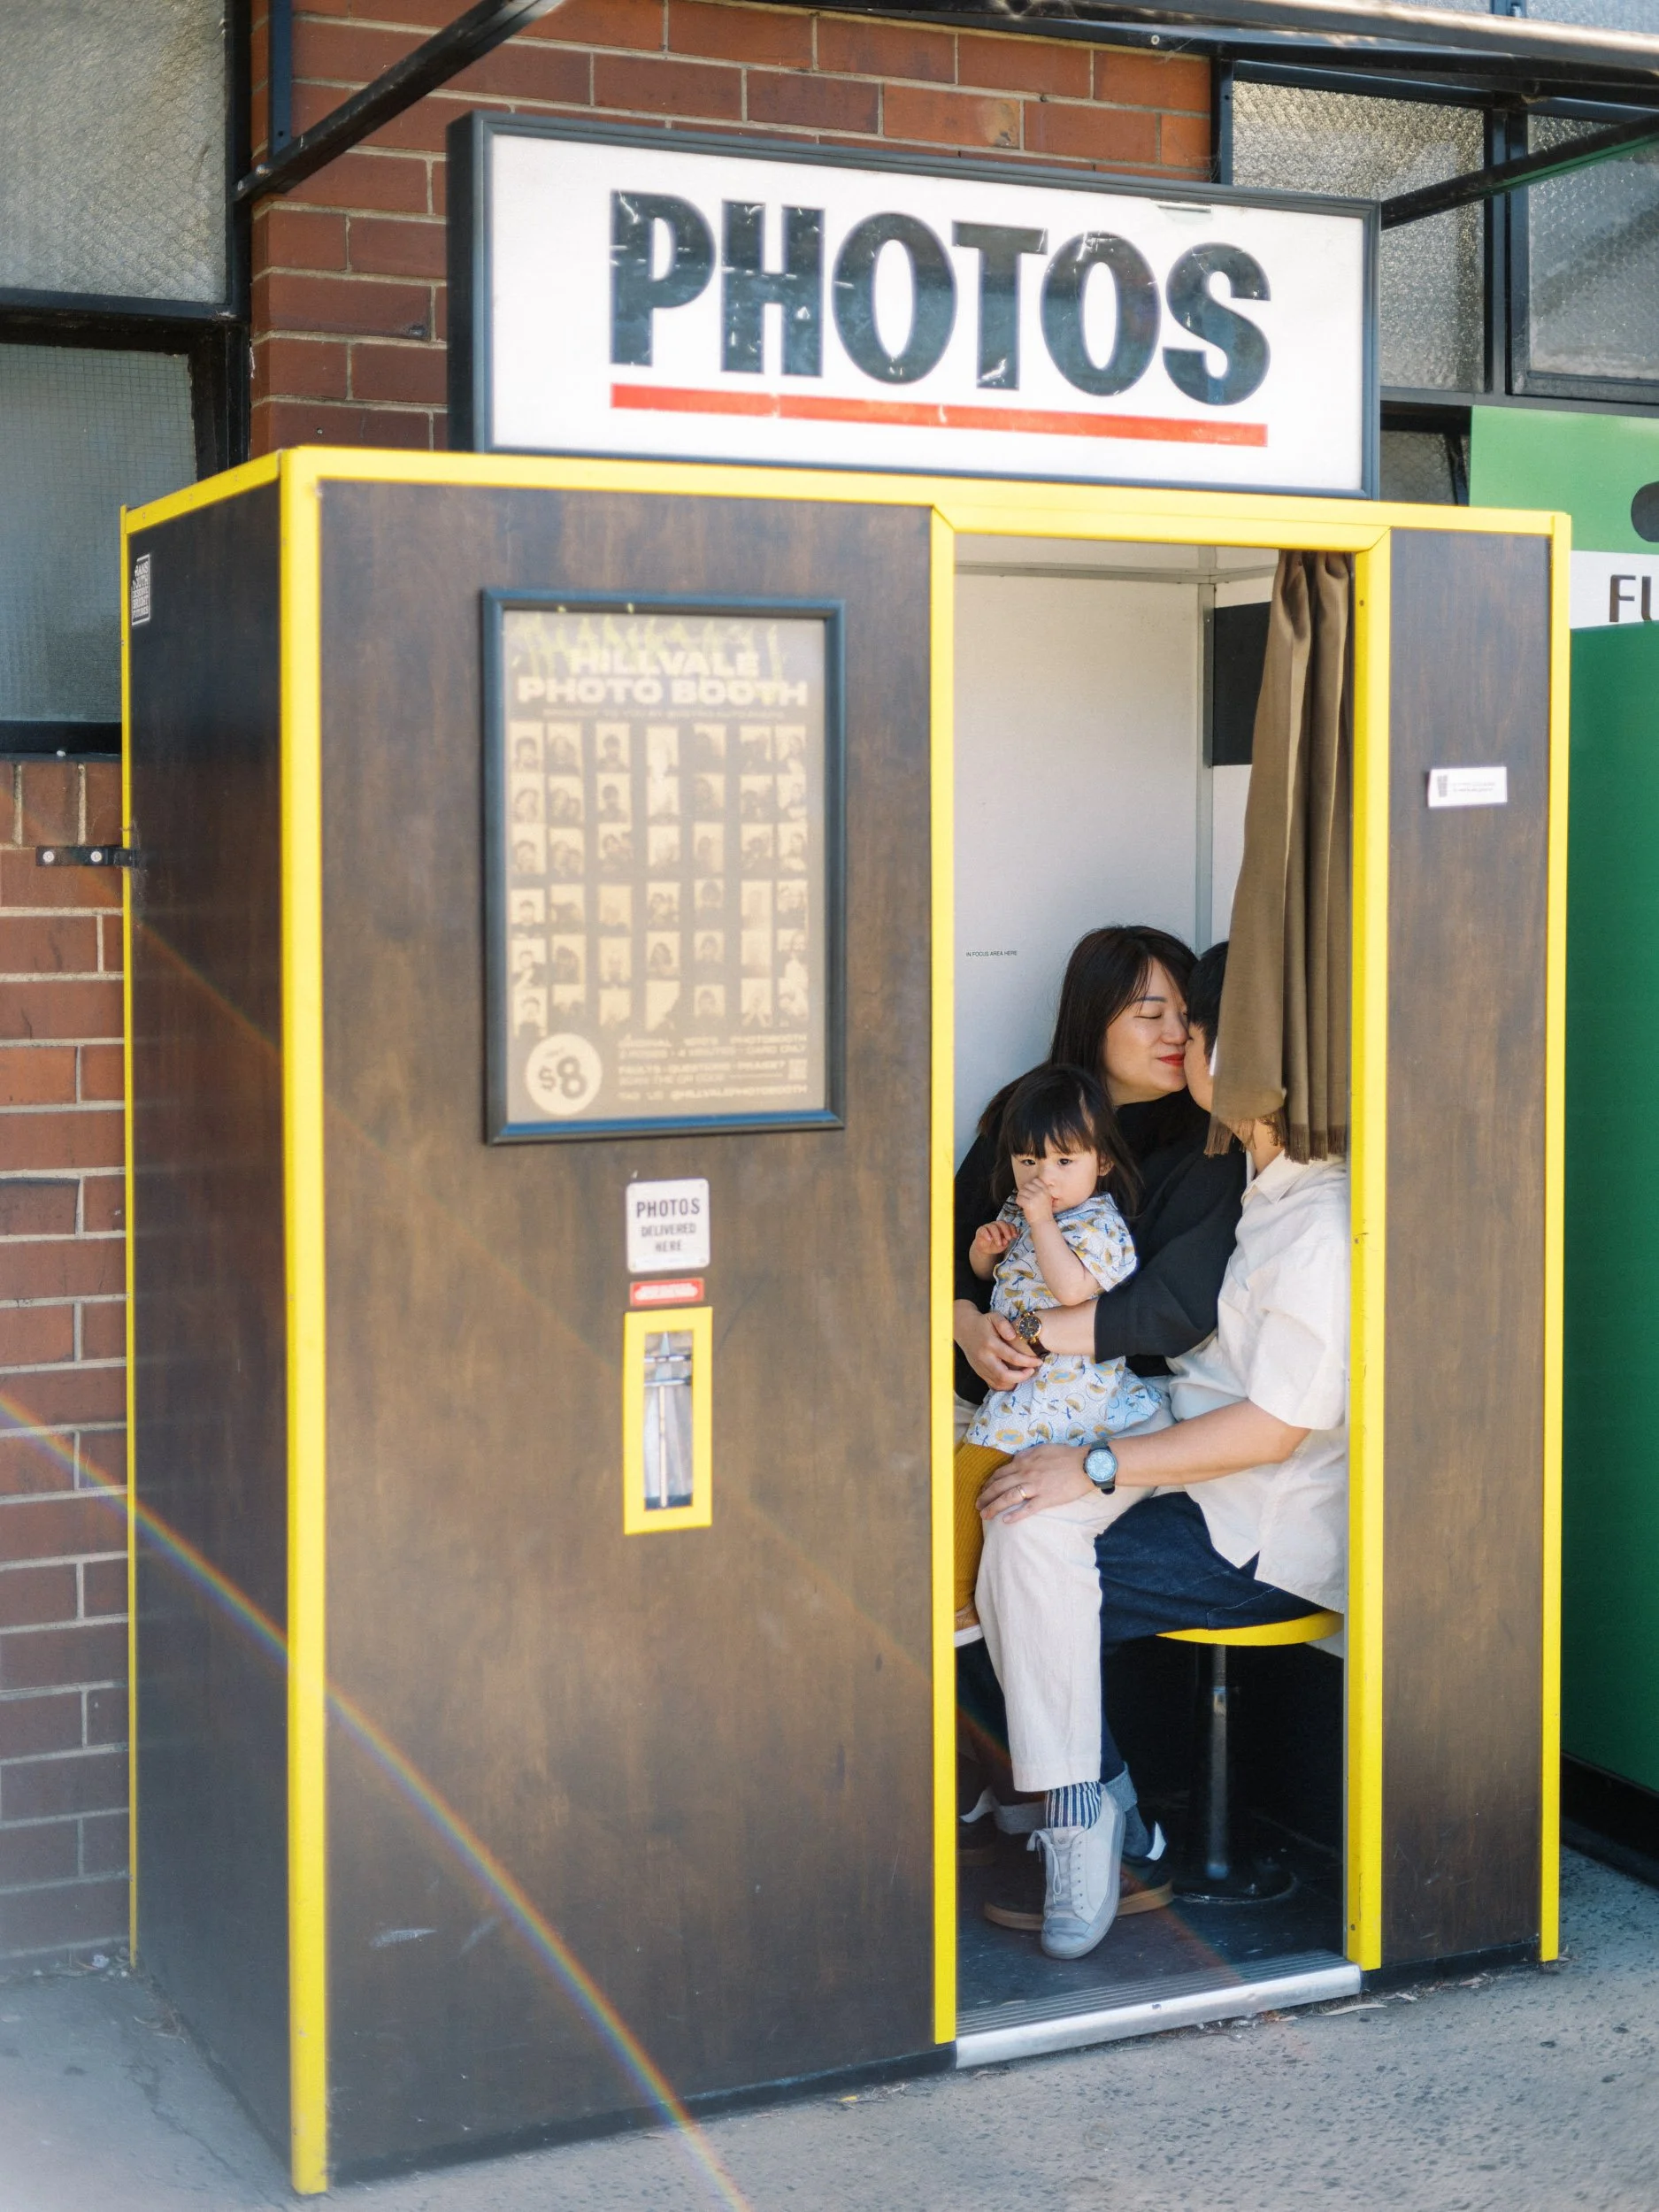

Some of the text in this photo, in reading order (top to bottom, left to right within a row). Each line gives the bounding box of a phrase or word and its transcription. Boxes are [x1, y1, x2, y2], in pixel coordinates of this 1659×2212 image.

[610, 189, 1271, 405] PHOTOS
[570, 649, 760, 678] HILLVALE
[517, 676, 809, 707] PHOTO BOOTH
[539, 1055, 588, 1100] $8
[636, 1197, 700, 1218] PHOTOS
[641, 1222, 696, 1238] DELIVERED
[655, 1240, 680, 1252] HERE
